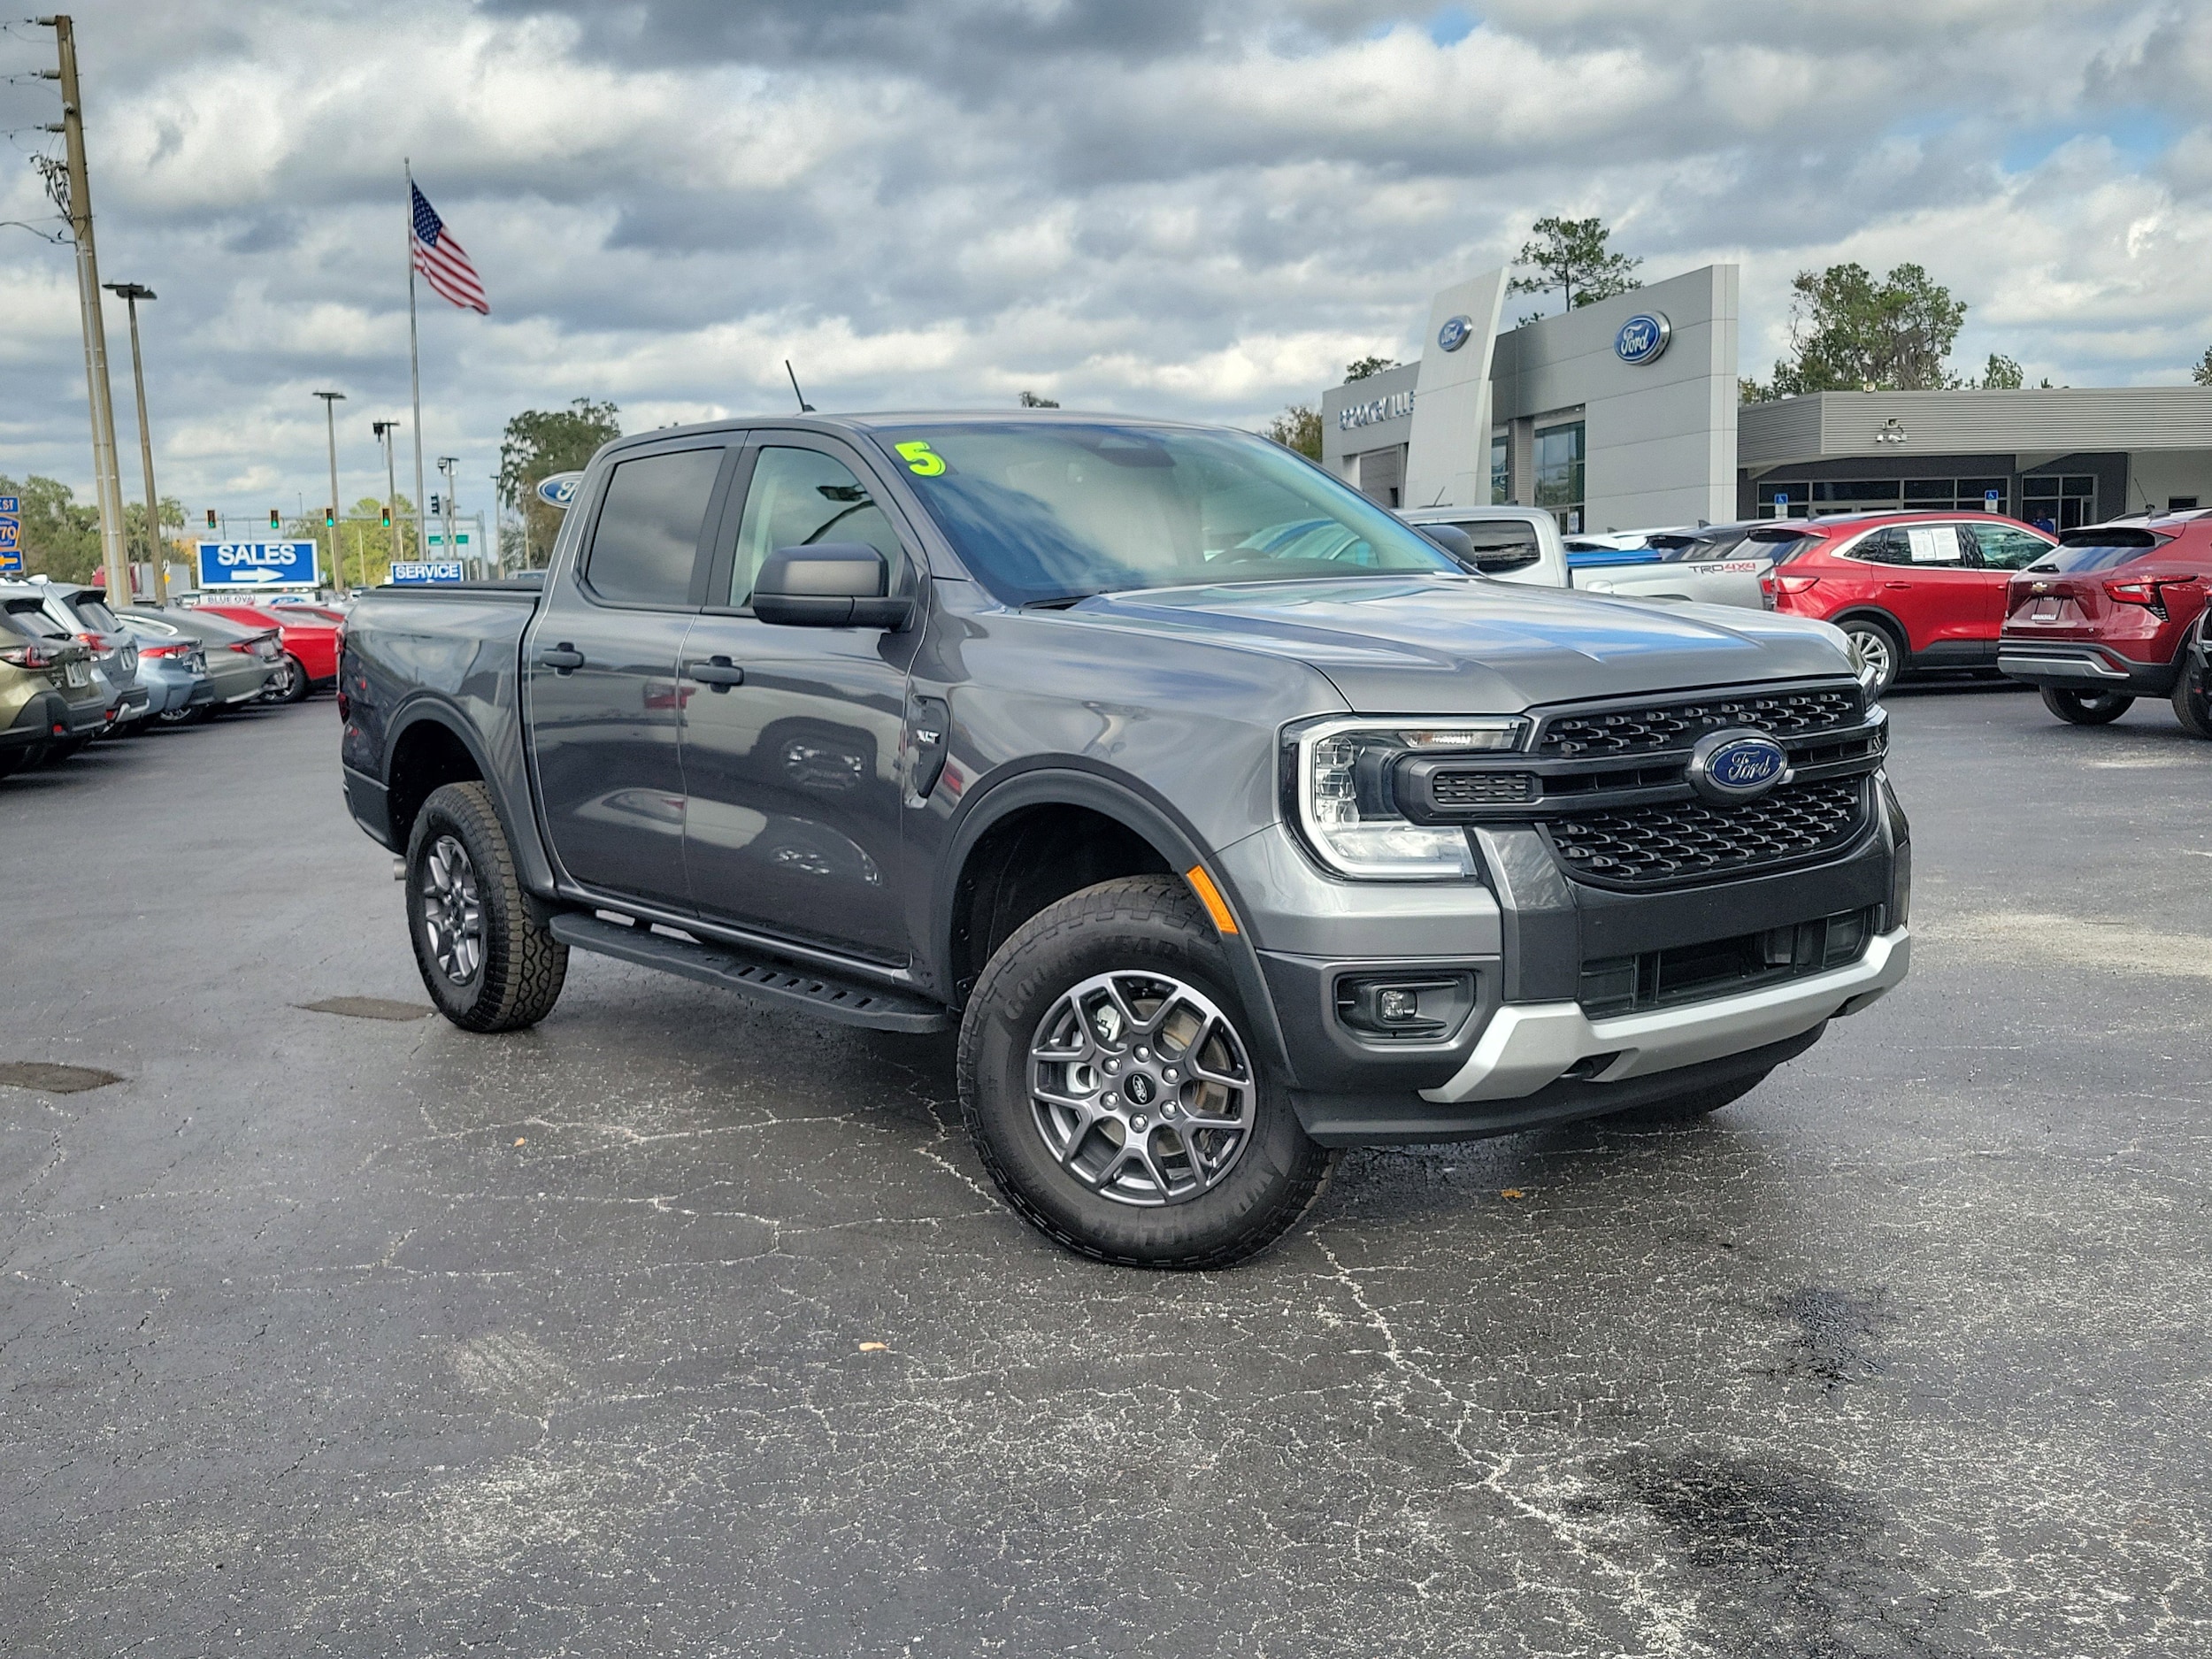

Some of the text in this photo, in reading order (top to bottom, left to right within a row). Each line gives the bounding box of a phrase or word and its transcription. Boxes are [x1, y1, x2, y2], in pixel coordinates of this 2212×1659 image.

[1621, 324, 1649, 355] Ford
[895, 442, 946, 477] 5
[217, 544, 296, 565] SALES
[396, 565, 459, 580] SERVICE
[1728, 750, 1770, 781] Ford
